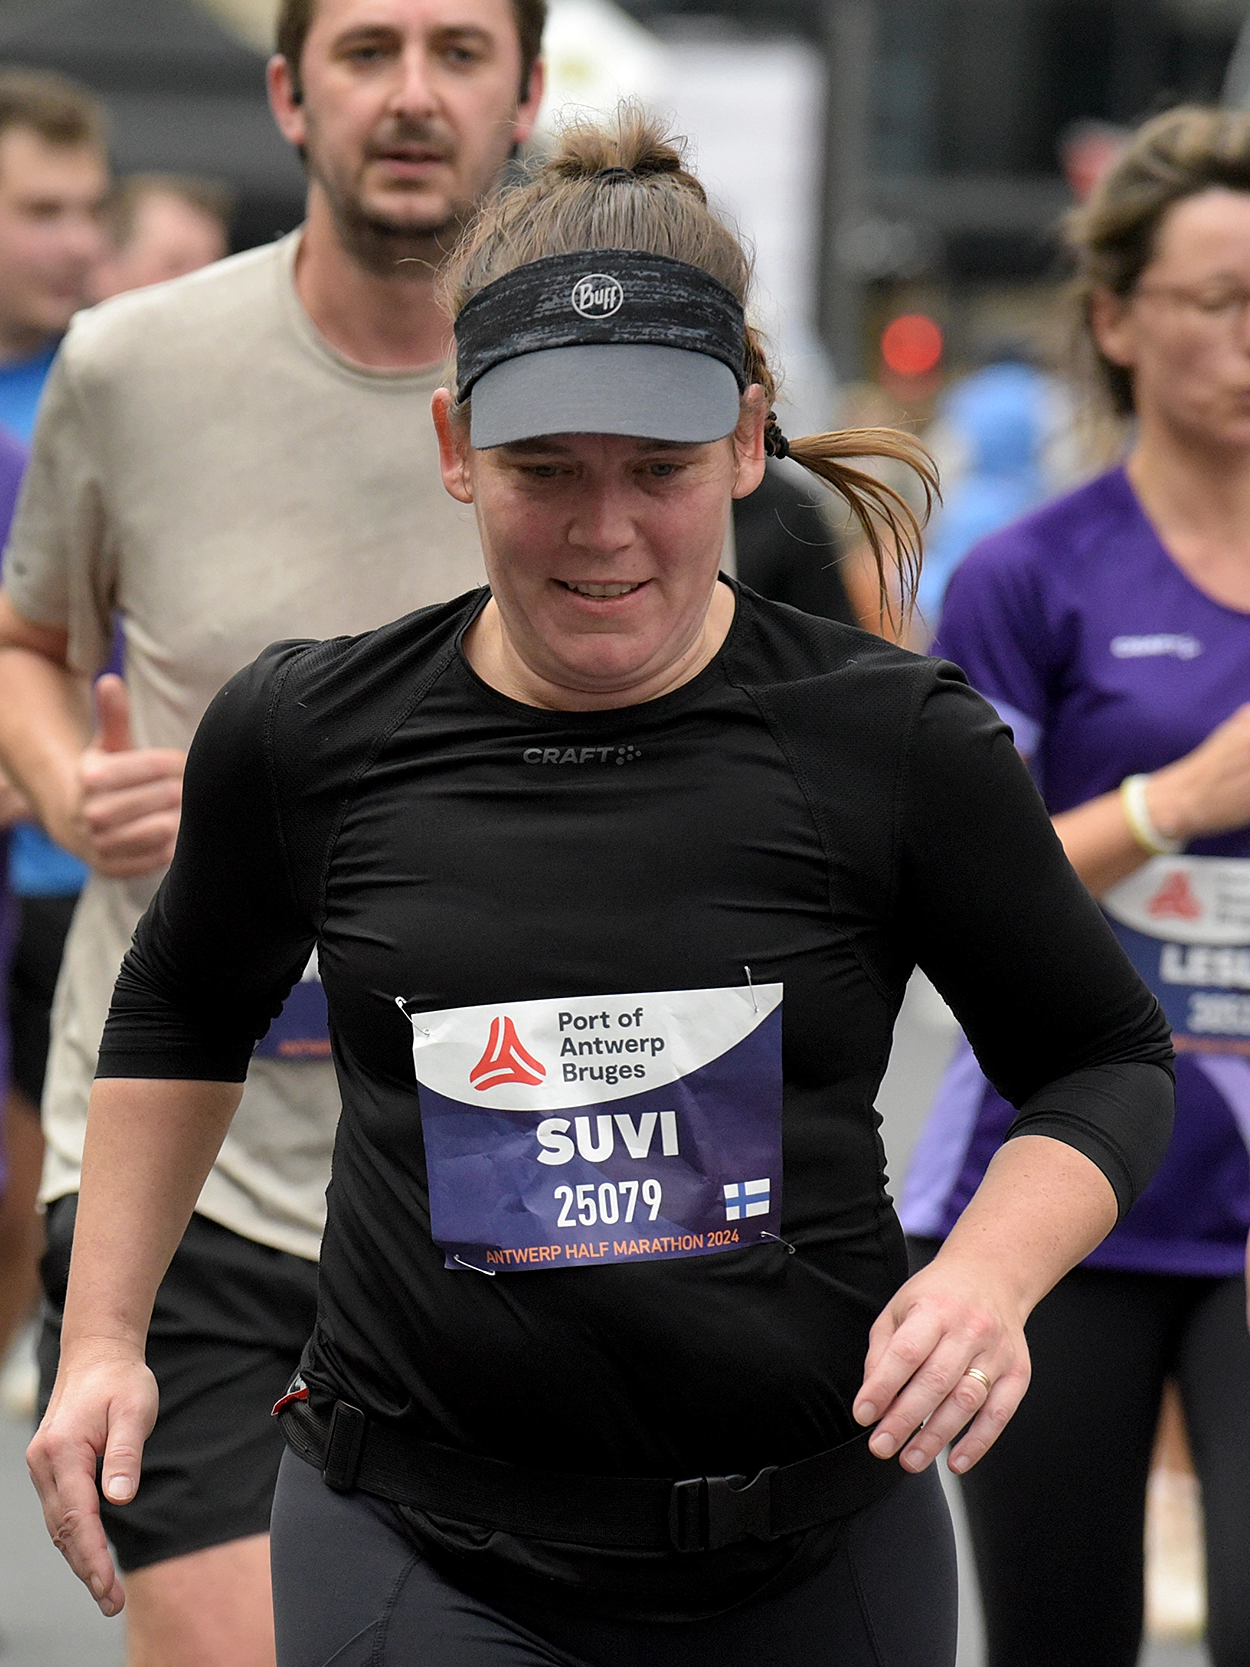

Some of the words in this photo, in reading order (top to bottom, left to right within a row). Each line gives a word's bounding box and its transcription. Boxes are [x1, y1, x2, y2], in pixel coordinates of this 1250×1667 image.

[579, 283, 618, 310] Buff
[522, 746, 615, 765] CRAFT
[558, 1011, 611, 1032] Port
[617, 1007, 644, 1028] of
[560, 1037, 665, 1057] Antwerp
[562, 1063, 646, 1085] Bruges
[536, 1111, 679, 1166] SUVI
[554, 1178, 662, 1228] 25079
[486, 1245, 561, 1264] ANTWERP
[565, 1242, 609, 1259] HALF
[613, 1234, 704, 1256] MARATHON
[707, 1228, 740, 1247] 2024
